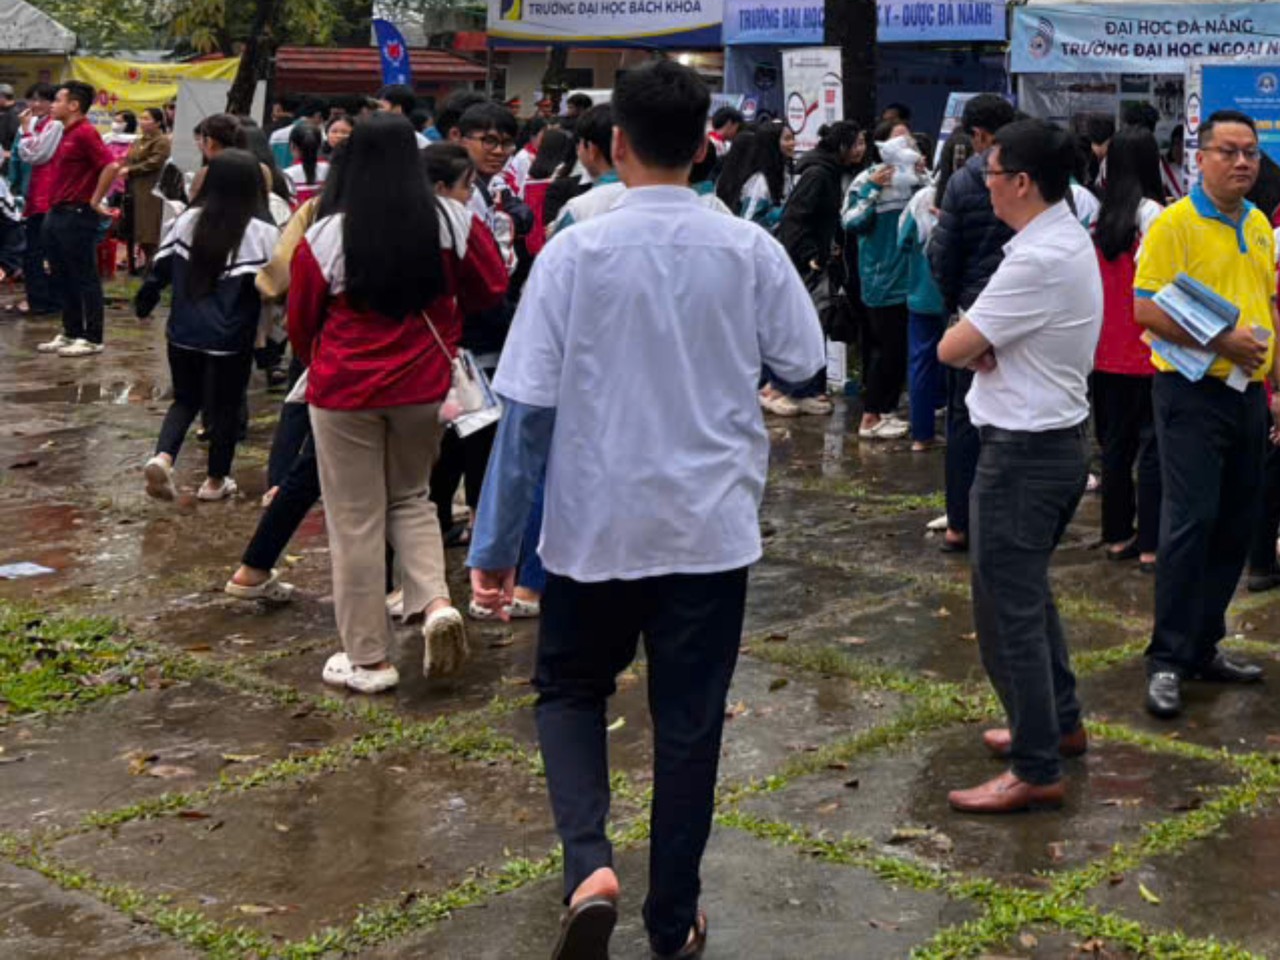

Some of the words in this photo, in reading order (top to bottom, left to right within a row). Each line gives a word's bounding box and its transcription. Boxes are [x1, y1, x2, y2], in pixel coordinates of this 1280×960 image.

[529, 1, 575, 15] TRƯỜNG
[578, 1, 598, 18] ĐẠI
[601, 1, 626, 18] HỌC
[666, 0, 701, 13] KHOA
[739, 4, 779, 31] TRƯỜNG
[782, 7, 801, 35] ĐẠI
[1105, 21, 1132, 39] ĐẠI
[1138, 19, 1172, 38] HỌC
[1177, 16, 1200, 35] ĐÀ
[1061, 40, 1129, 57] TRƯỜNG
[1133, 42, 1162, 61] ĐẠI
[1208, 41, 1261, 60] NGOẠI
